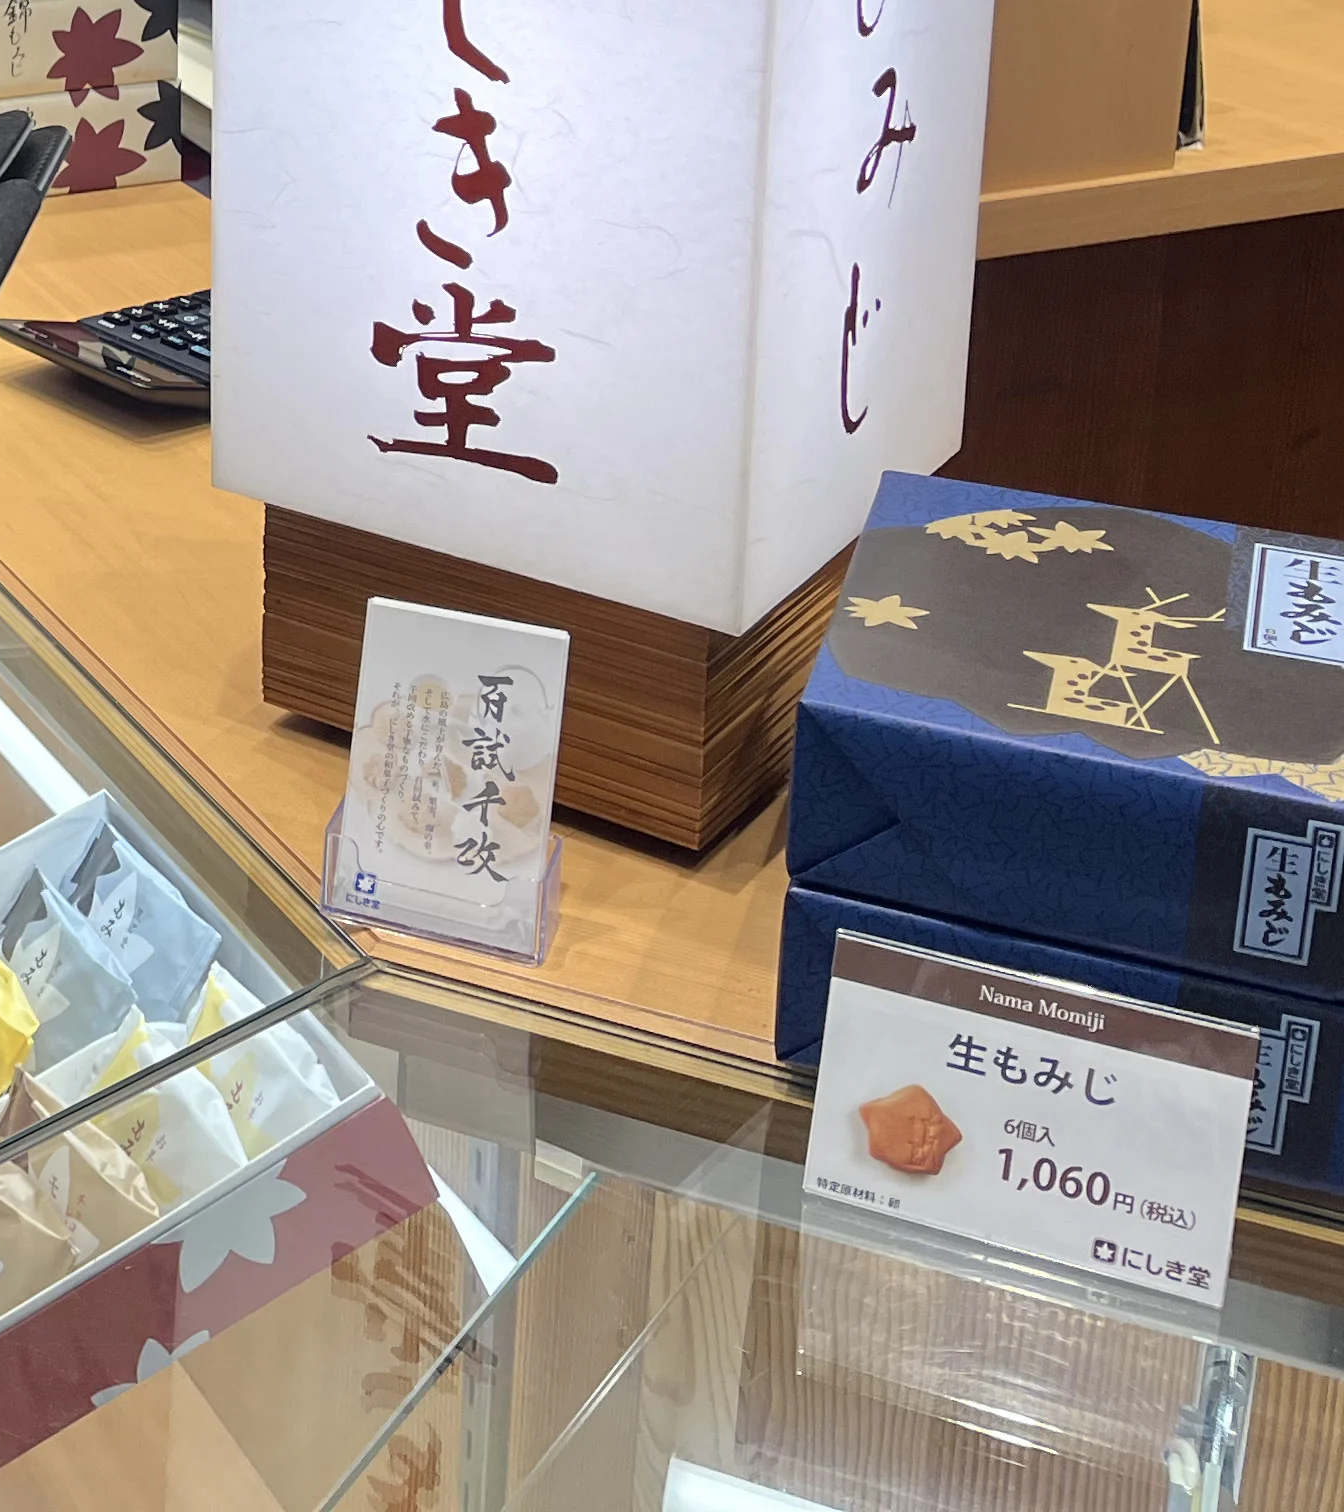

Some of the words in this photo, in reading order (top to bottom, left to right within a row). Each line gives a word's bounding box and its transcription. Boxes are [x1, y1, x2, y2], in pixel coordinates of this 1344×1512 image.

[454, 674, 516, 883] 百試千改
[346, 893, 381, 911] にしき堂
[1258, 845, 1300, 948] 生もみじ
[979, 984, 1034, 1013] Nama
[1038, 999, 1106, 1033] Momiji
[946, 1032, 1118, 1107] 生もみじ
[1004, 1118, 1057, 1148] 6個入
[1121, 1246, 1212, 1291] にしき堂
